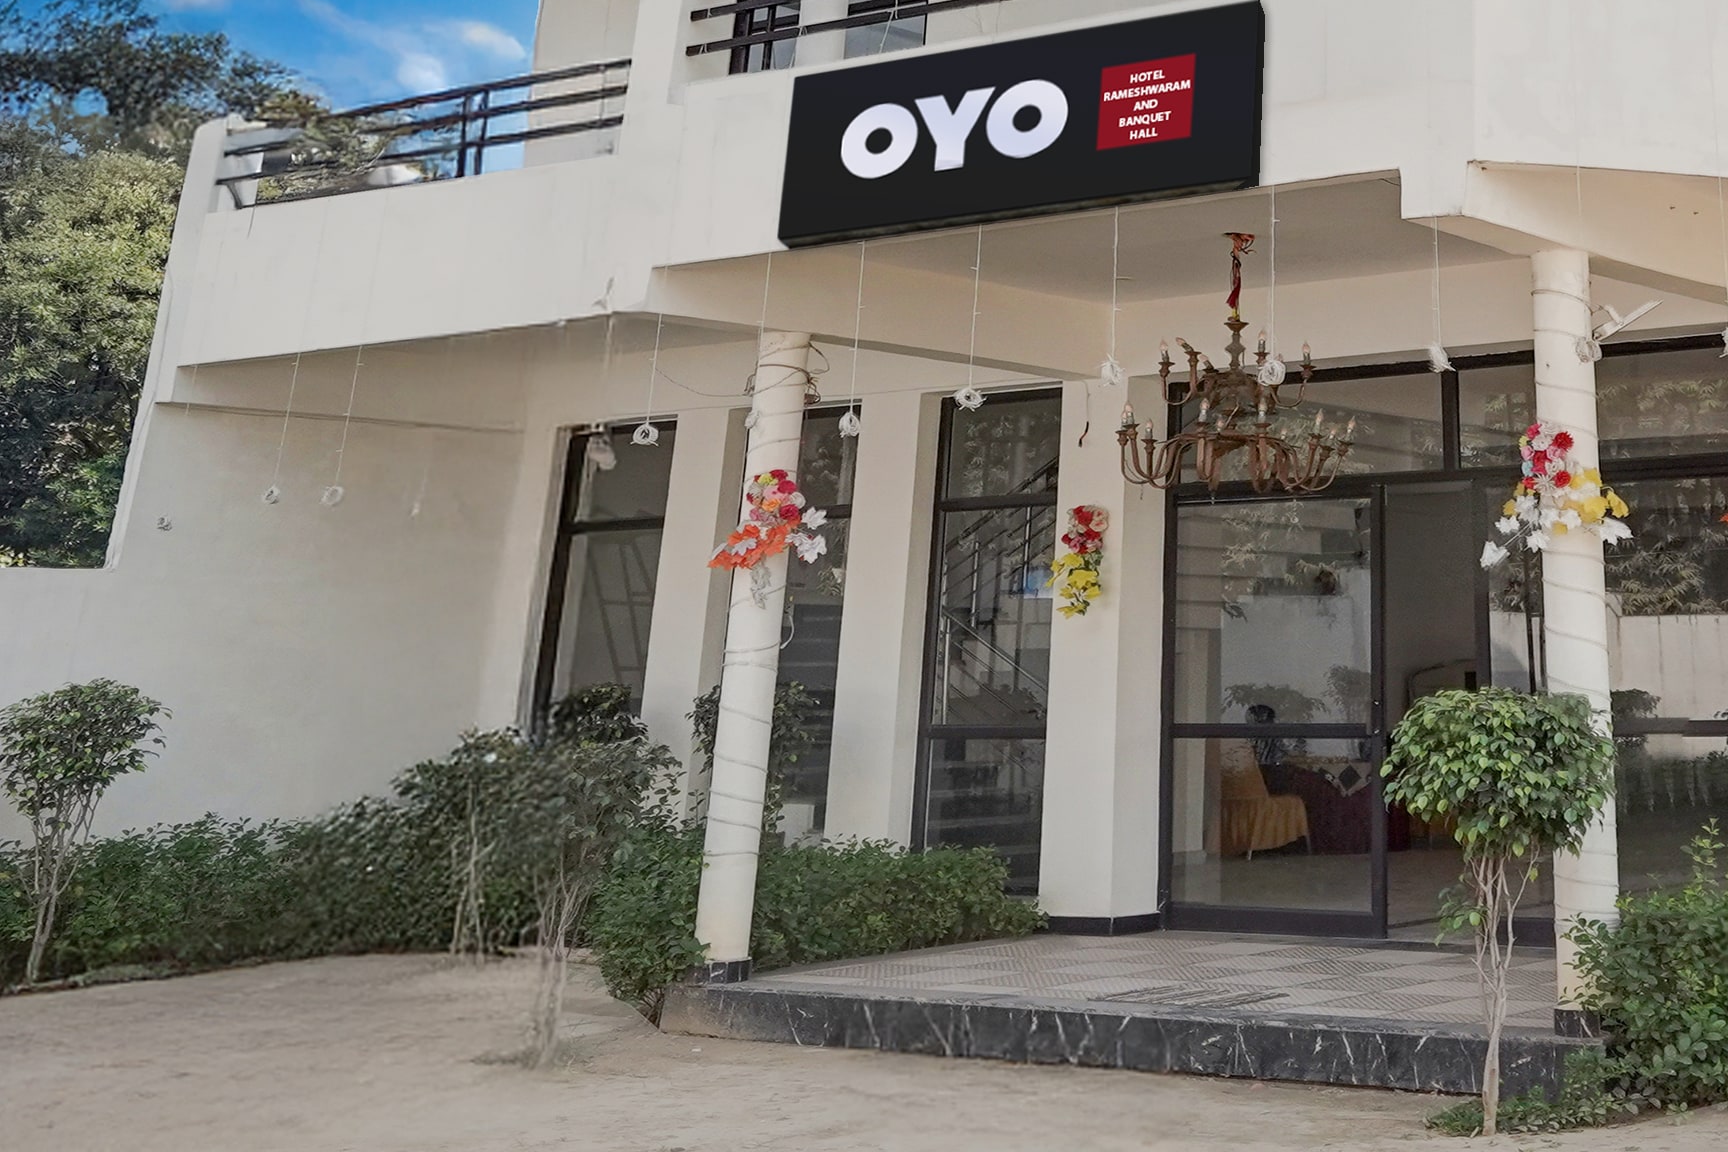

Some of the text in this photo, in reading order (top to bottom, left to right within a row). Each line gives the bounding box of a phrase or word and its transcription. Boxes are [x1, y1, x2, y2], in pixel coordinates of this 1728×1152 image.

[1129, 69, 1166, 84] HOTEL
[1103, 79, 1191, 102] RAMESHWARAM
[1133, 99, 1158, 111] AND
[1118, 110, 1172, 128] BANQUET
[840, 79, 1069, 179] OYO
[1129, 127, 1158, 140] HALL
